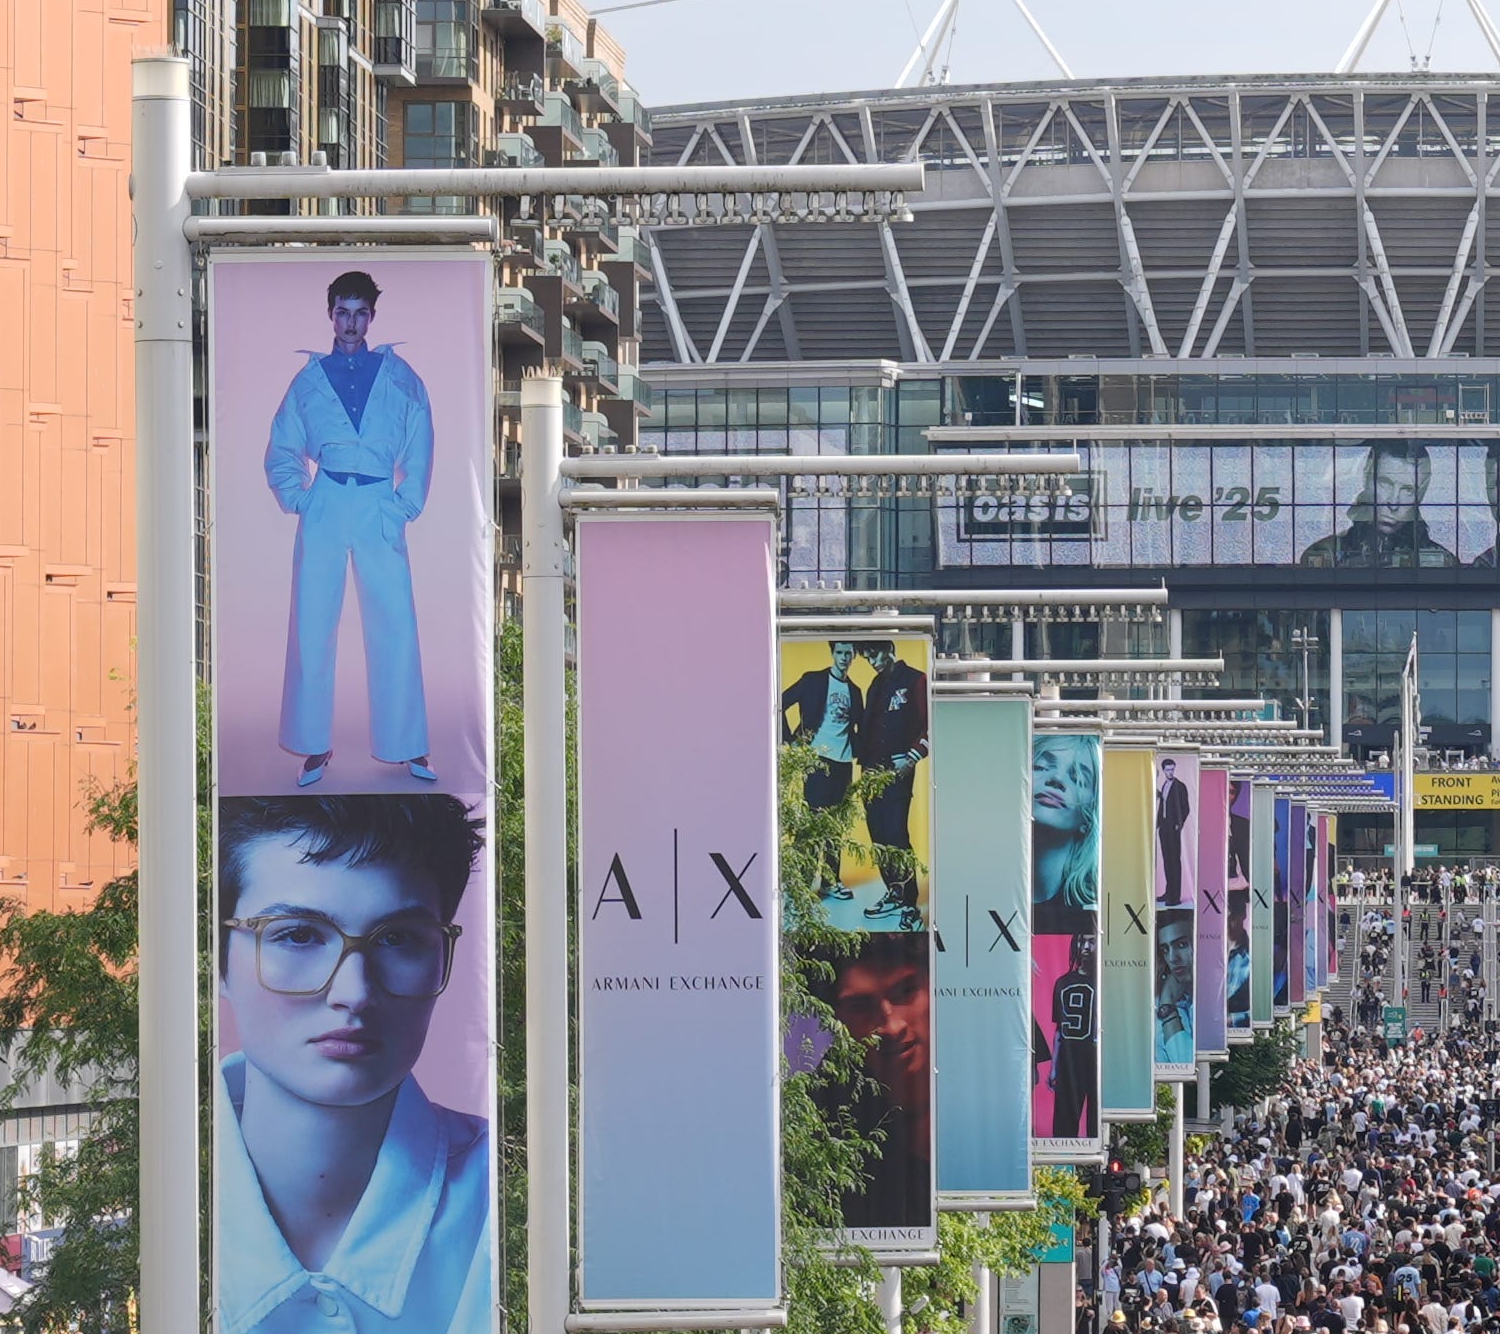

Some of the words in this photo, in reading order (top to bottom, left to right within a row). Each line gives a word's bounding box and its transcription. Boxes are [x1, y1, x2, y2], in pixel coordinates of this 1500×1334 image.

[971, 489, 1092, 522] oasis
[1126, 487, 1203, 522] live
[1214, 486, 1281, 522] '25
[1431, 777, 1472, 788] FRONT
[1421, 794, 1484, 806] STANDING
[592, 976, 660, 992] ARMANI
[669, 975, 765, 991] EXCHANGE
[962, 987, 1022, 998] EXCHANGE
[1061, 983, 1095, 1040] 9
